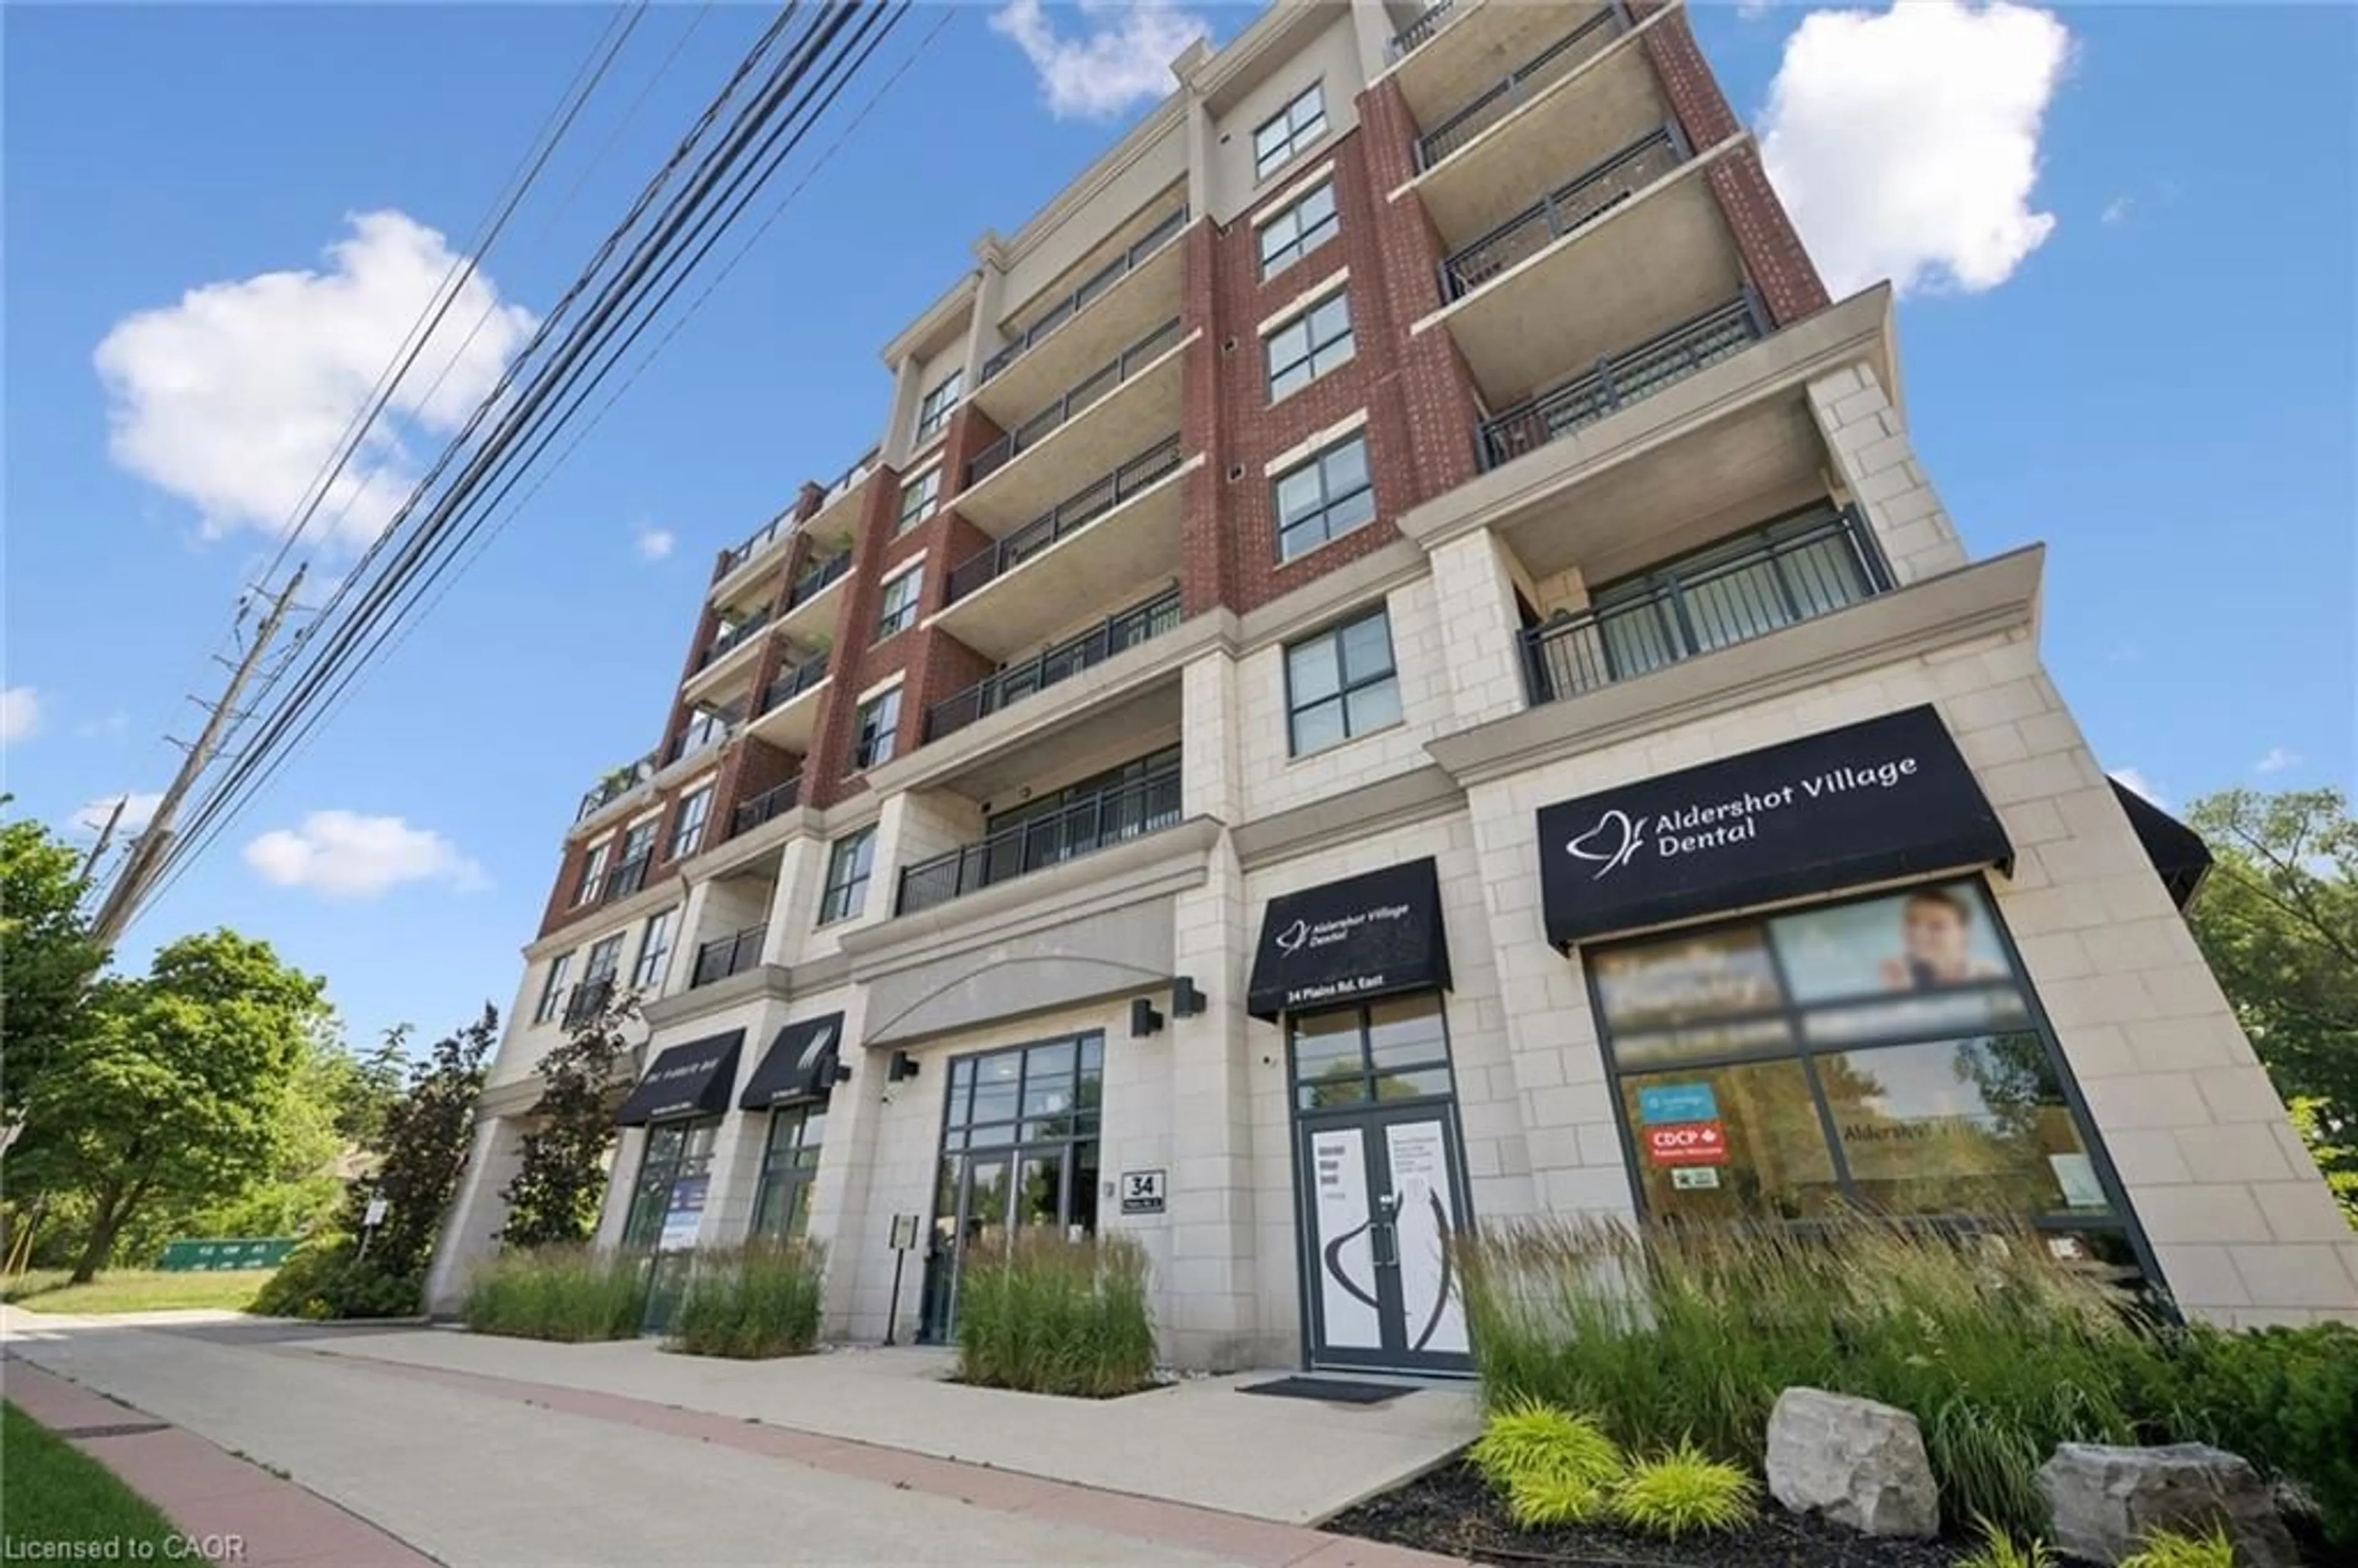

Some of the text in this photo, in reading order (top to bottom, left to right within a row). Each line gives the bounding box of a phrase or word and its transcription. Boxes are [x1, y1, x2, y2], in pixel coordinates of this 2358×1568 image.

[1656, 757, 1917, 834] Aldershot Village
[1659, 817, 1756, 857] Dental
[1653, 1130, 1698, 1147] CDCP
[1131, 1176, 1153, 1196] 34
